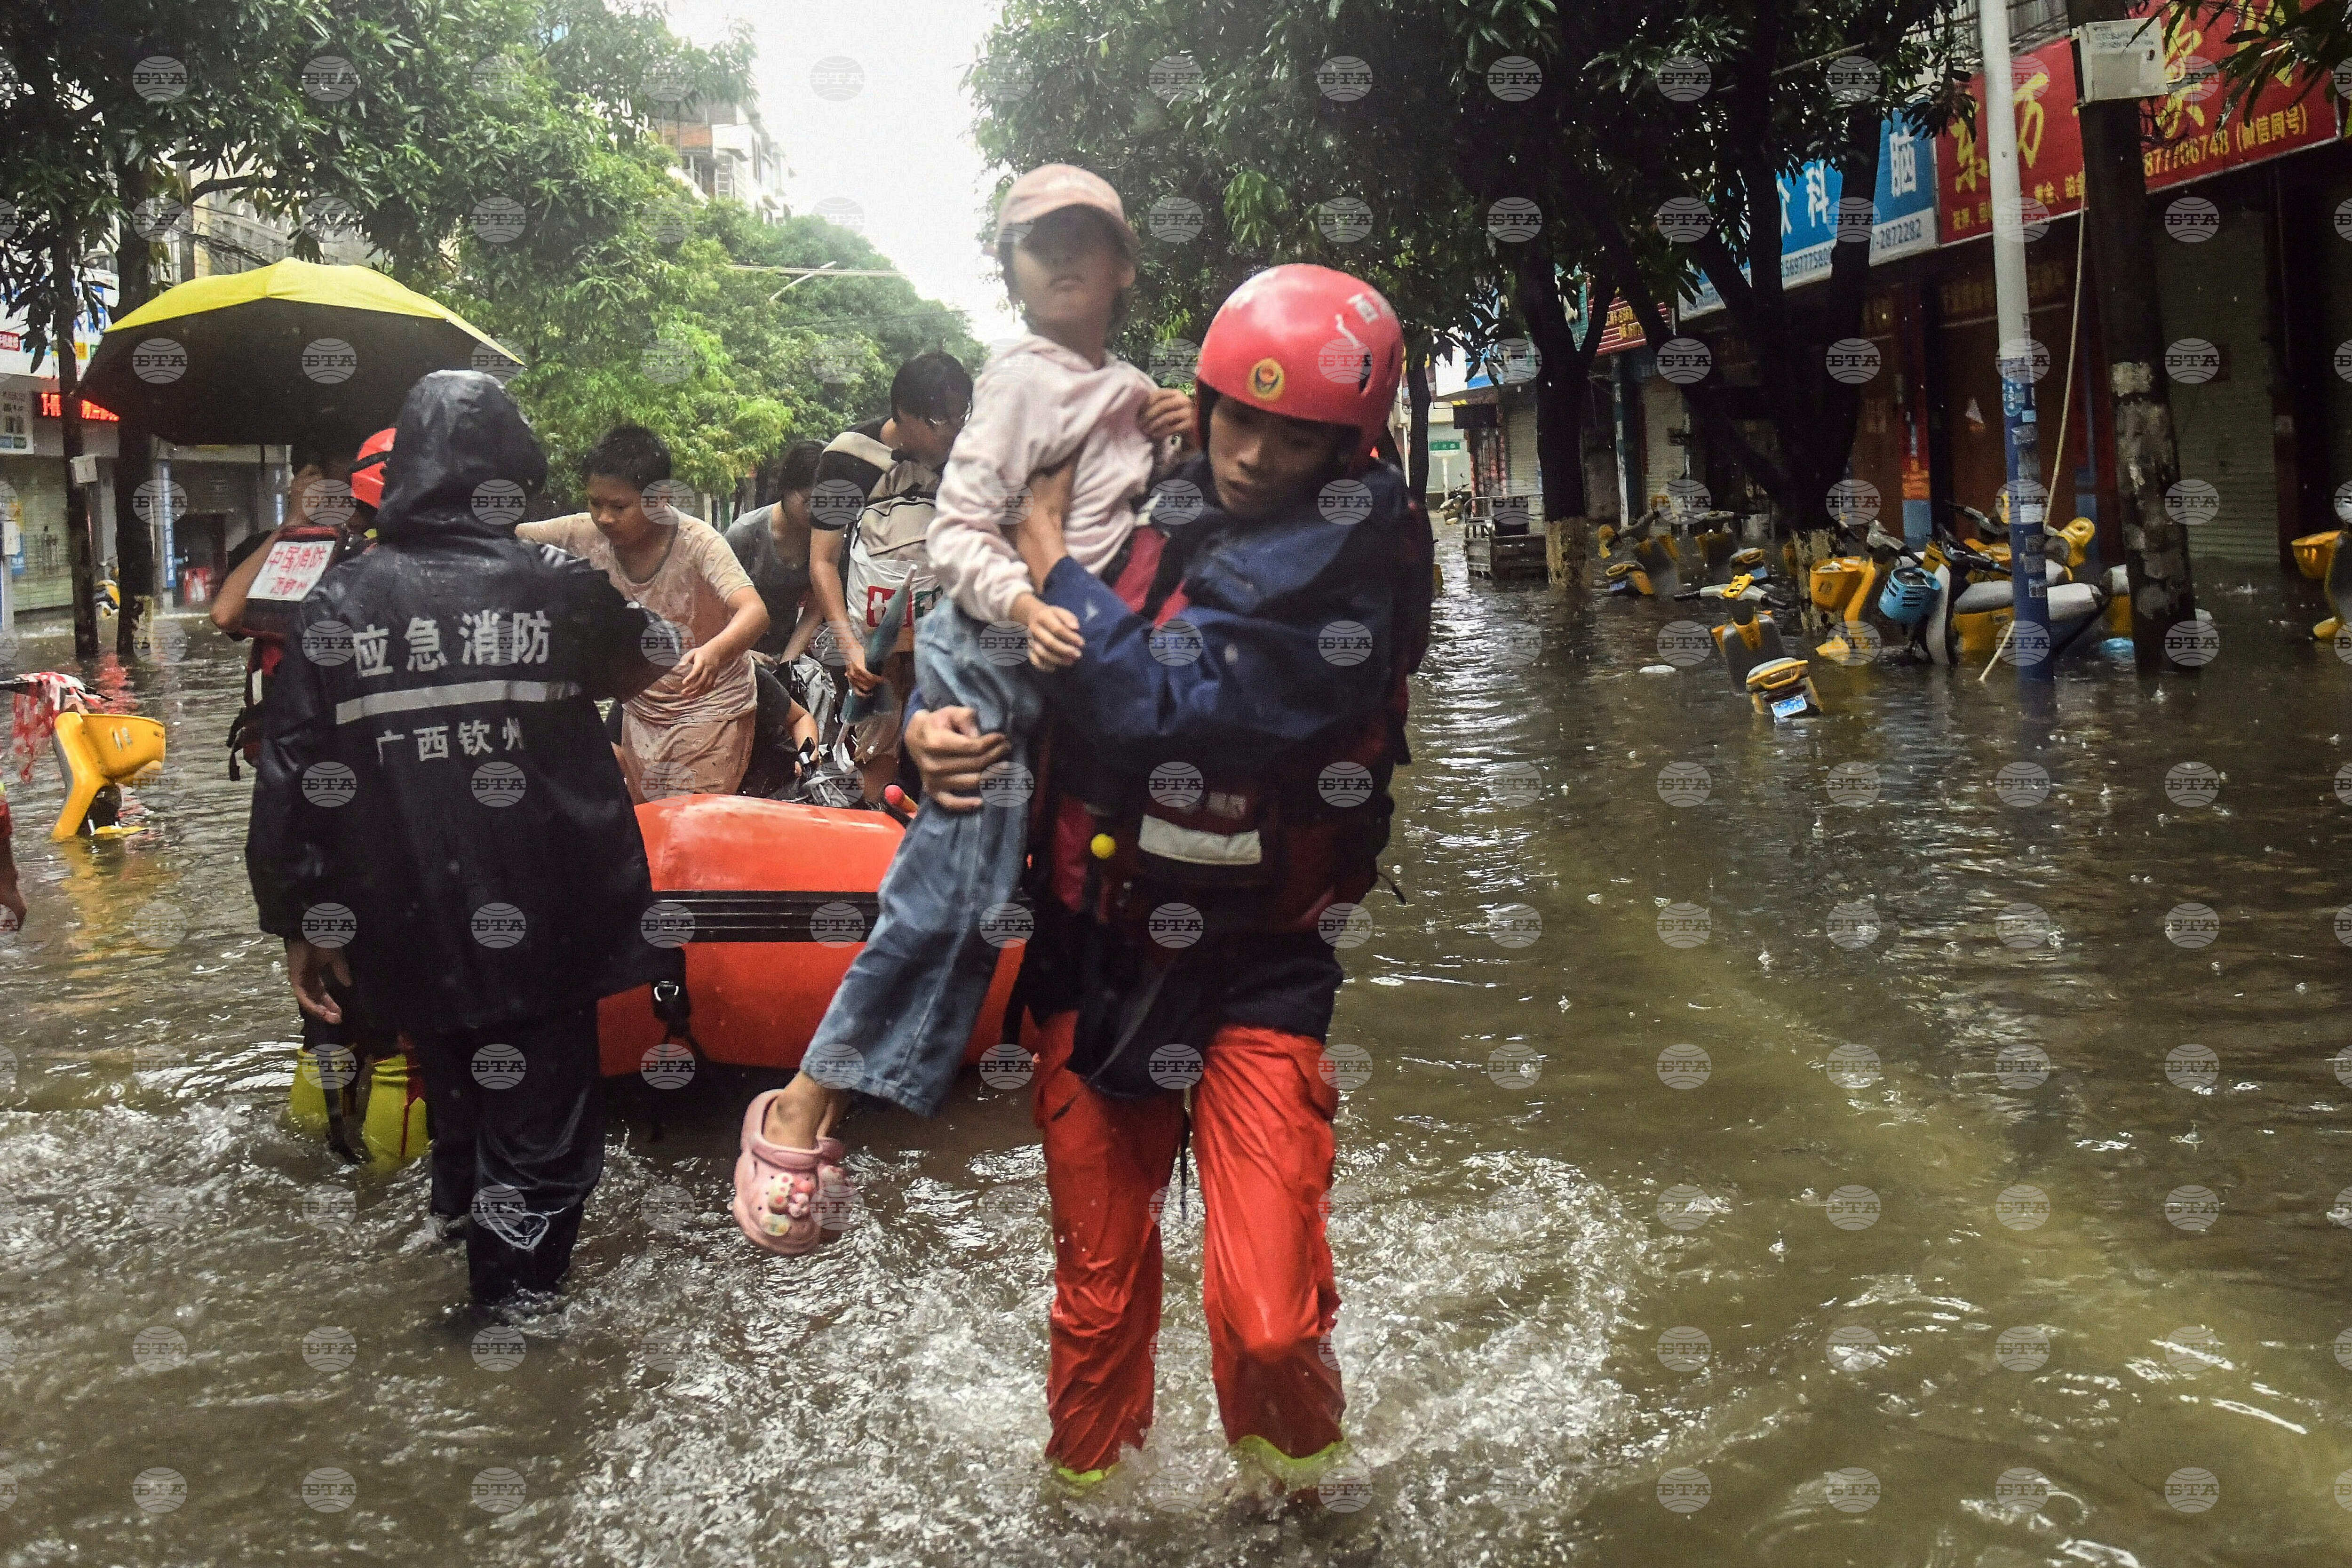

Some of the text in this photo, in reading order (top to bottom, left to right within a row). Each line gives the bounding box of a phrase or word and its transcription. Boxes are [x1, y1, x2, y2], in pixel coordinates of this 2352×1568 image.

[353, 610, 551, 678] 应急消防
[376, 717, 524, 765] 广西钦州
